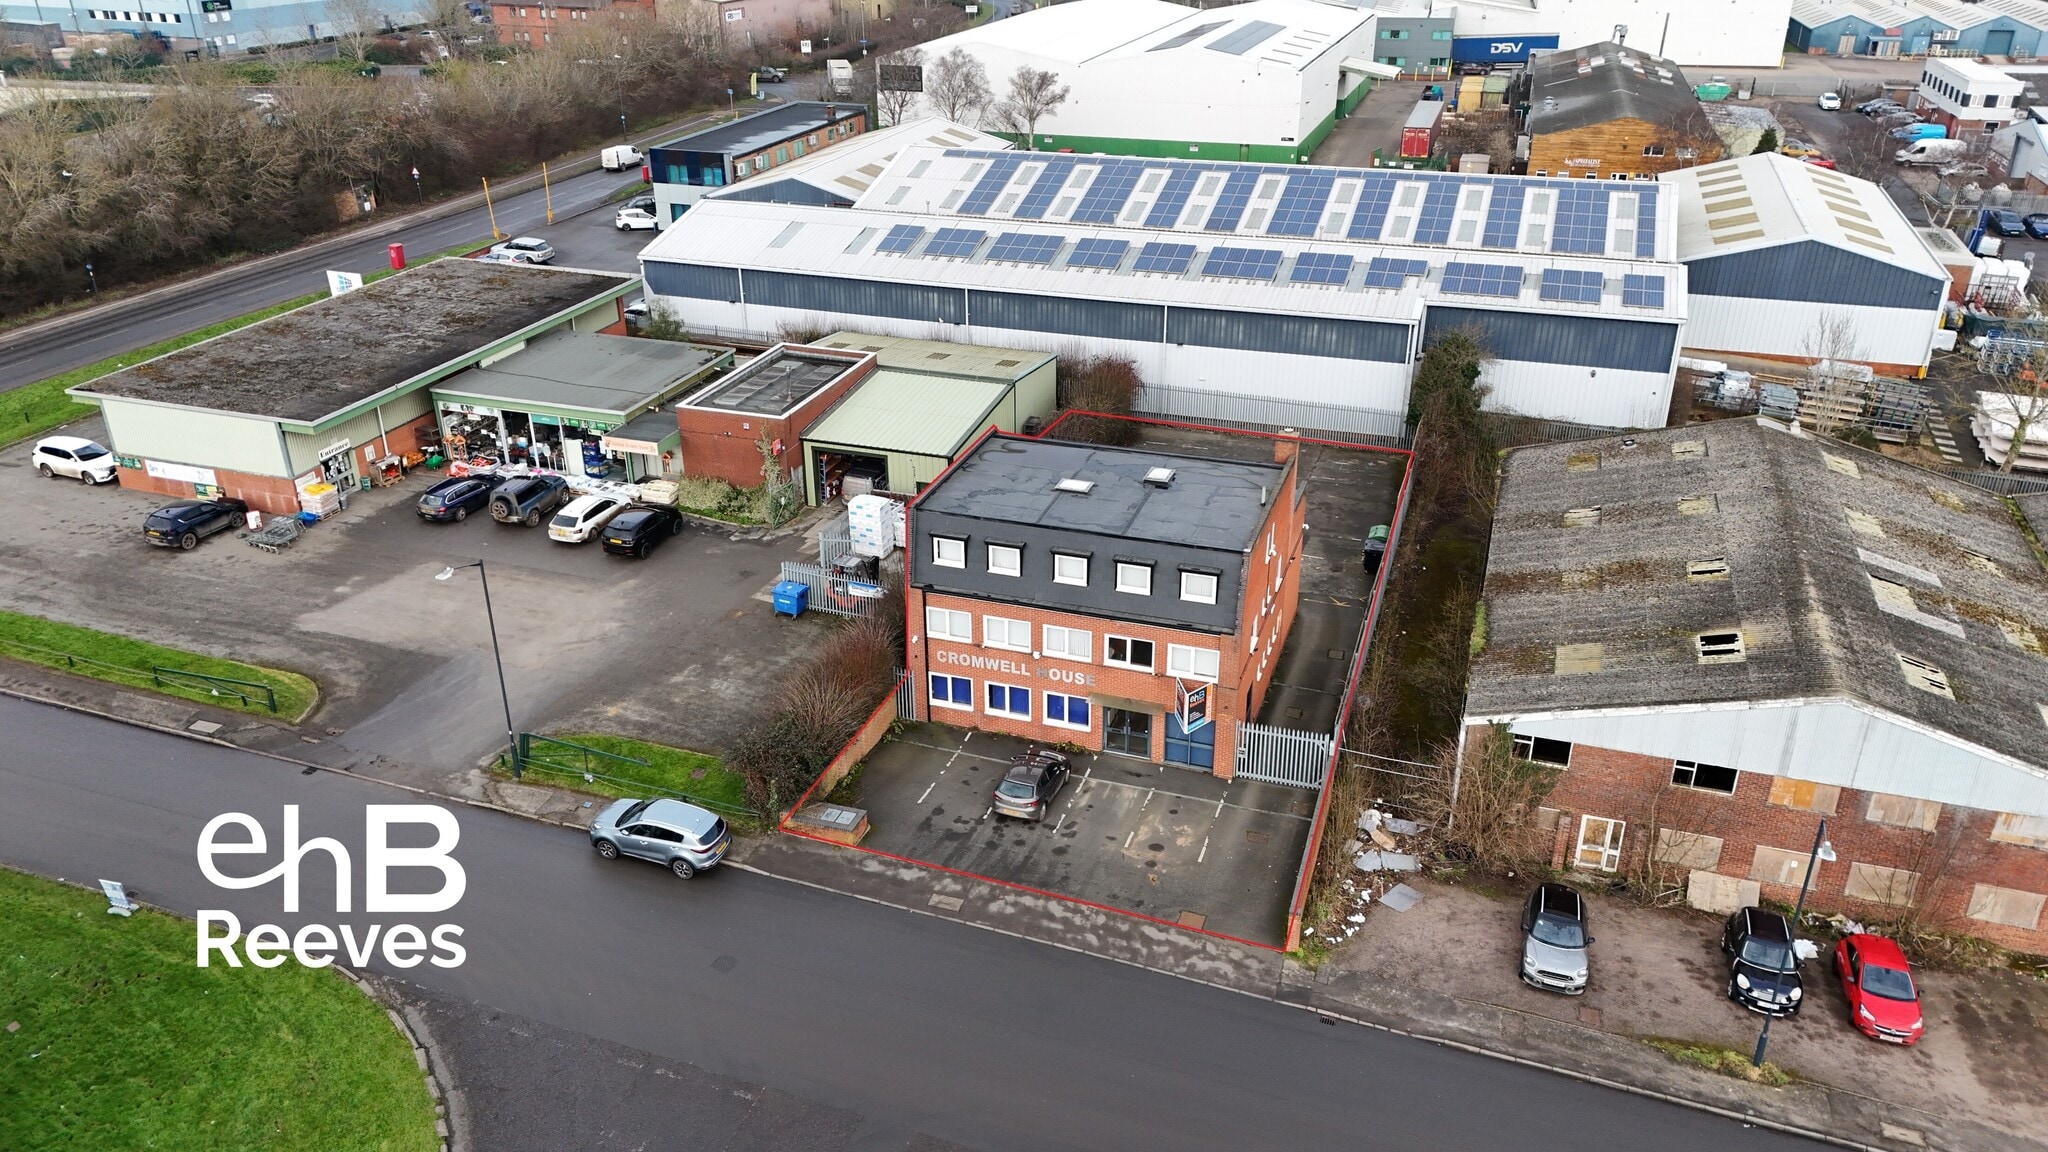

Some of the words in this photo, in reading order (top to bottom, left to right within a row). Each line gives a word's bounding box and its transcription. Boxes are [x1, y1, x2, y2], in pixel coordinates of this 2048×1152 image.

[1490, 42, 1523, 54] DSV
[320, 441, 349, 459] Entrance
[936, 650, 1031, 676] CROMWELL
[1037, 667, 1096, 687] HOUSE
[1190, 690, 1205, 703] ehB
